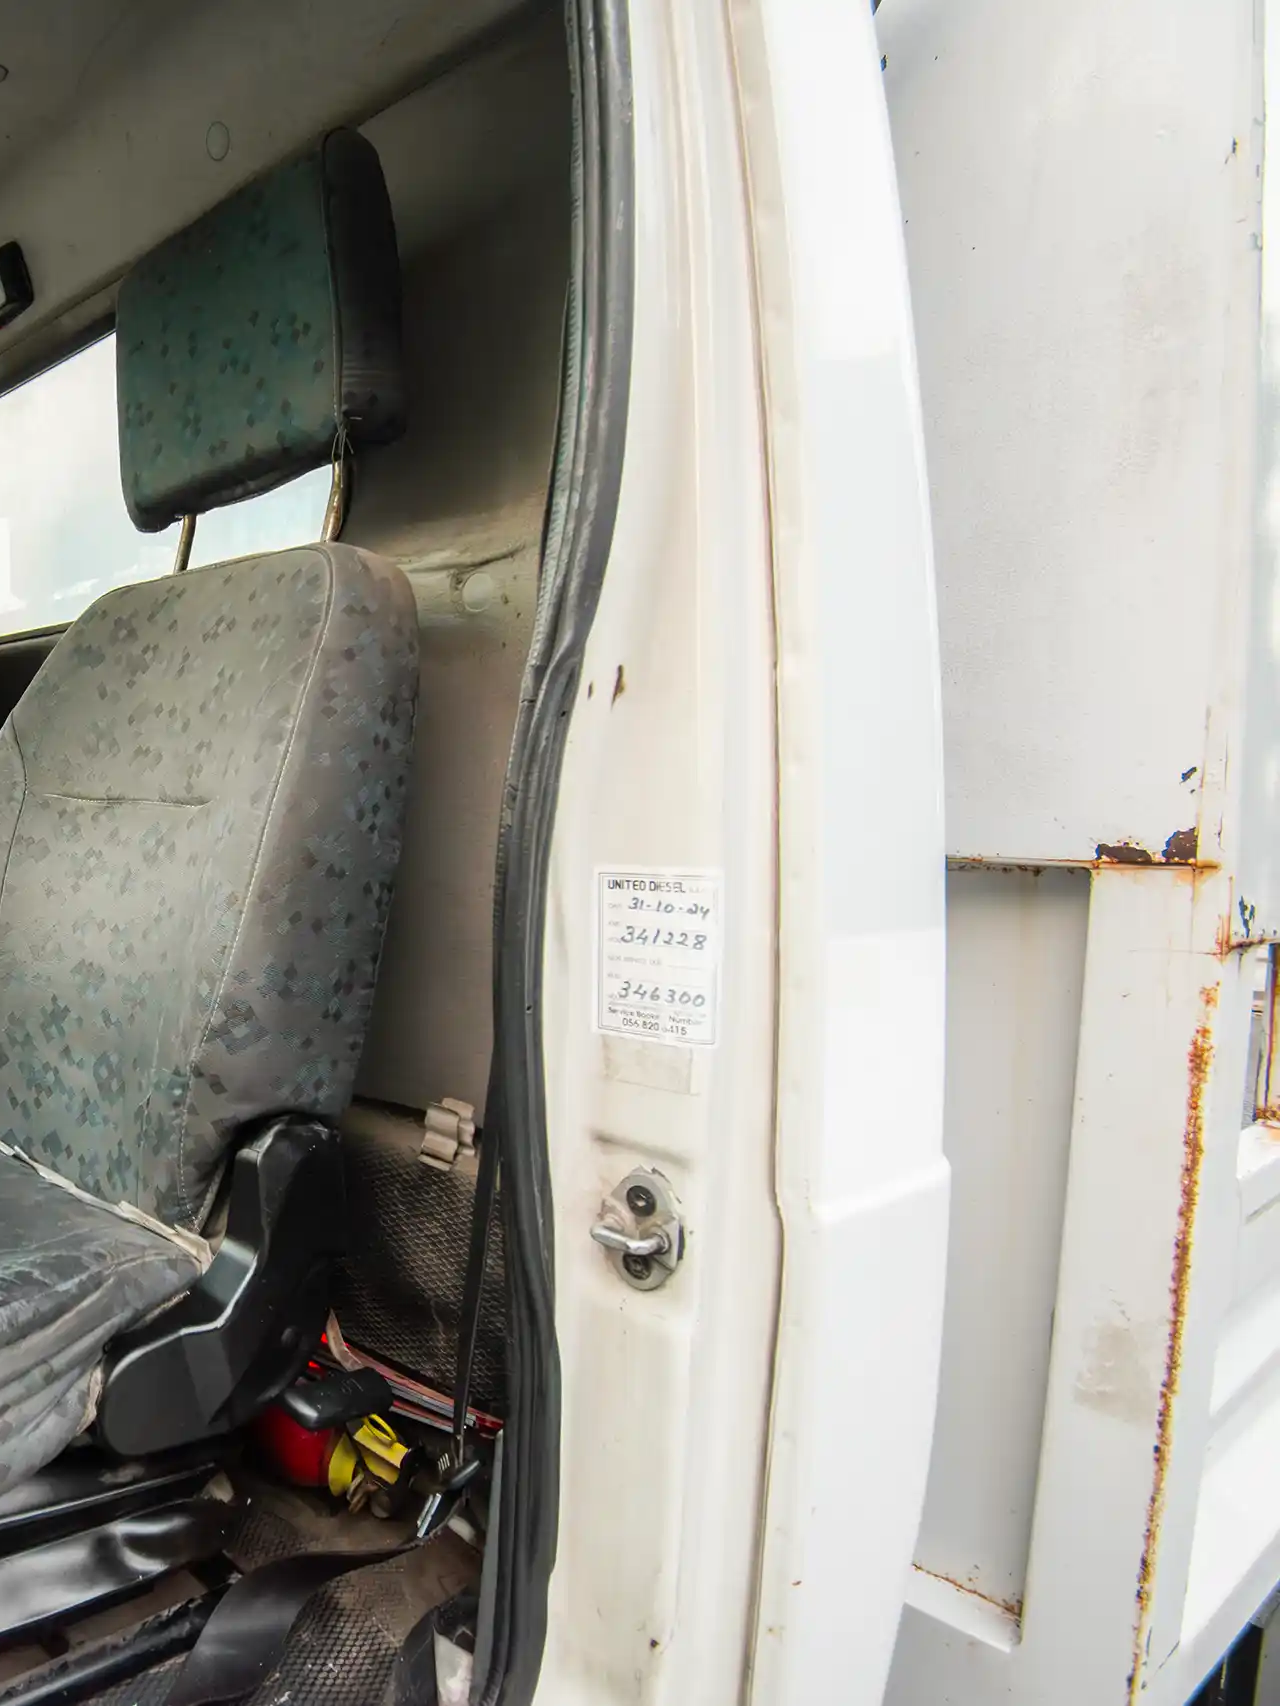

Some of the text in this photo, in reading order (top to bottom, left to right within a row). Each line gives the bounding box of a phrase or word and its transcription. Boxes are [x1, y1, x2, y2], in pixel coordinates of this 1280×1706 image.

[607, 879, 646, 891] UNITED
[649, 880, 686, 893] DIESEL
[621, 925, 707, 951] 341228
[618, 980, 706, 1008] 346300
[642, 1020, 660, 1032] 820
